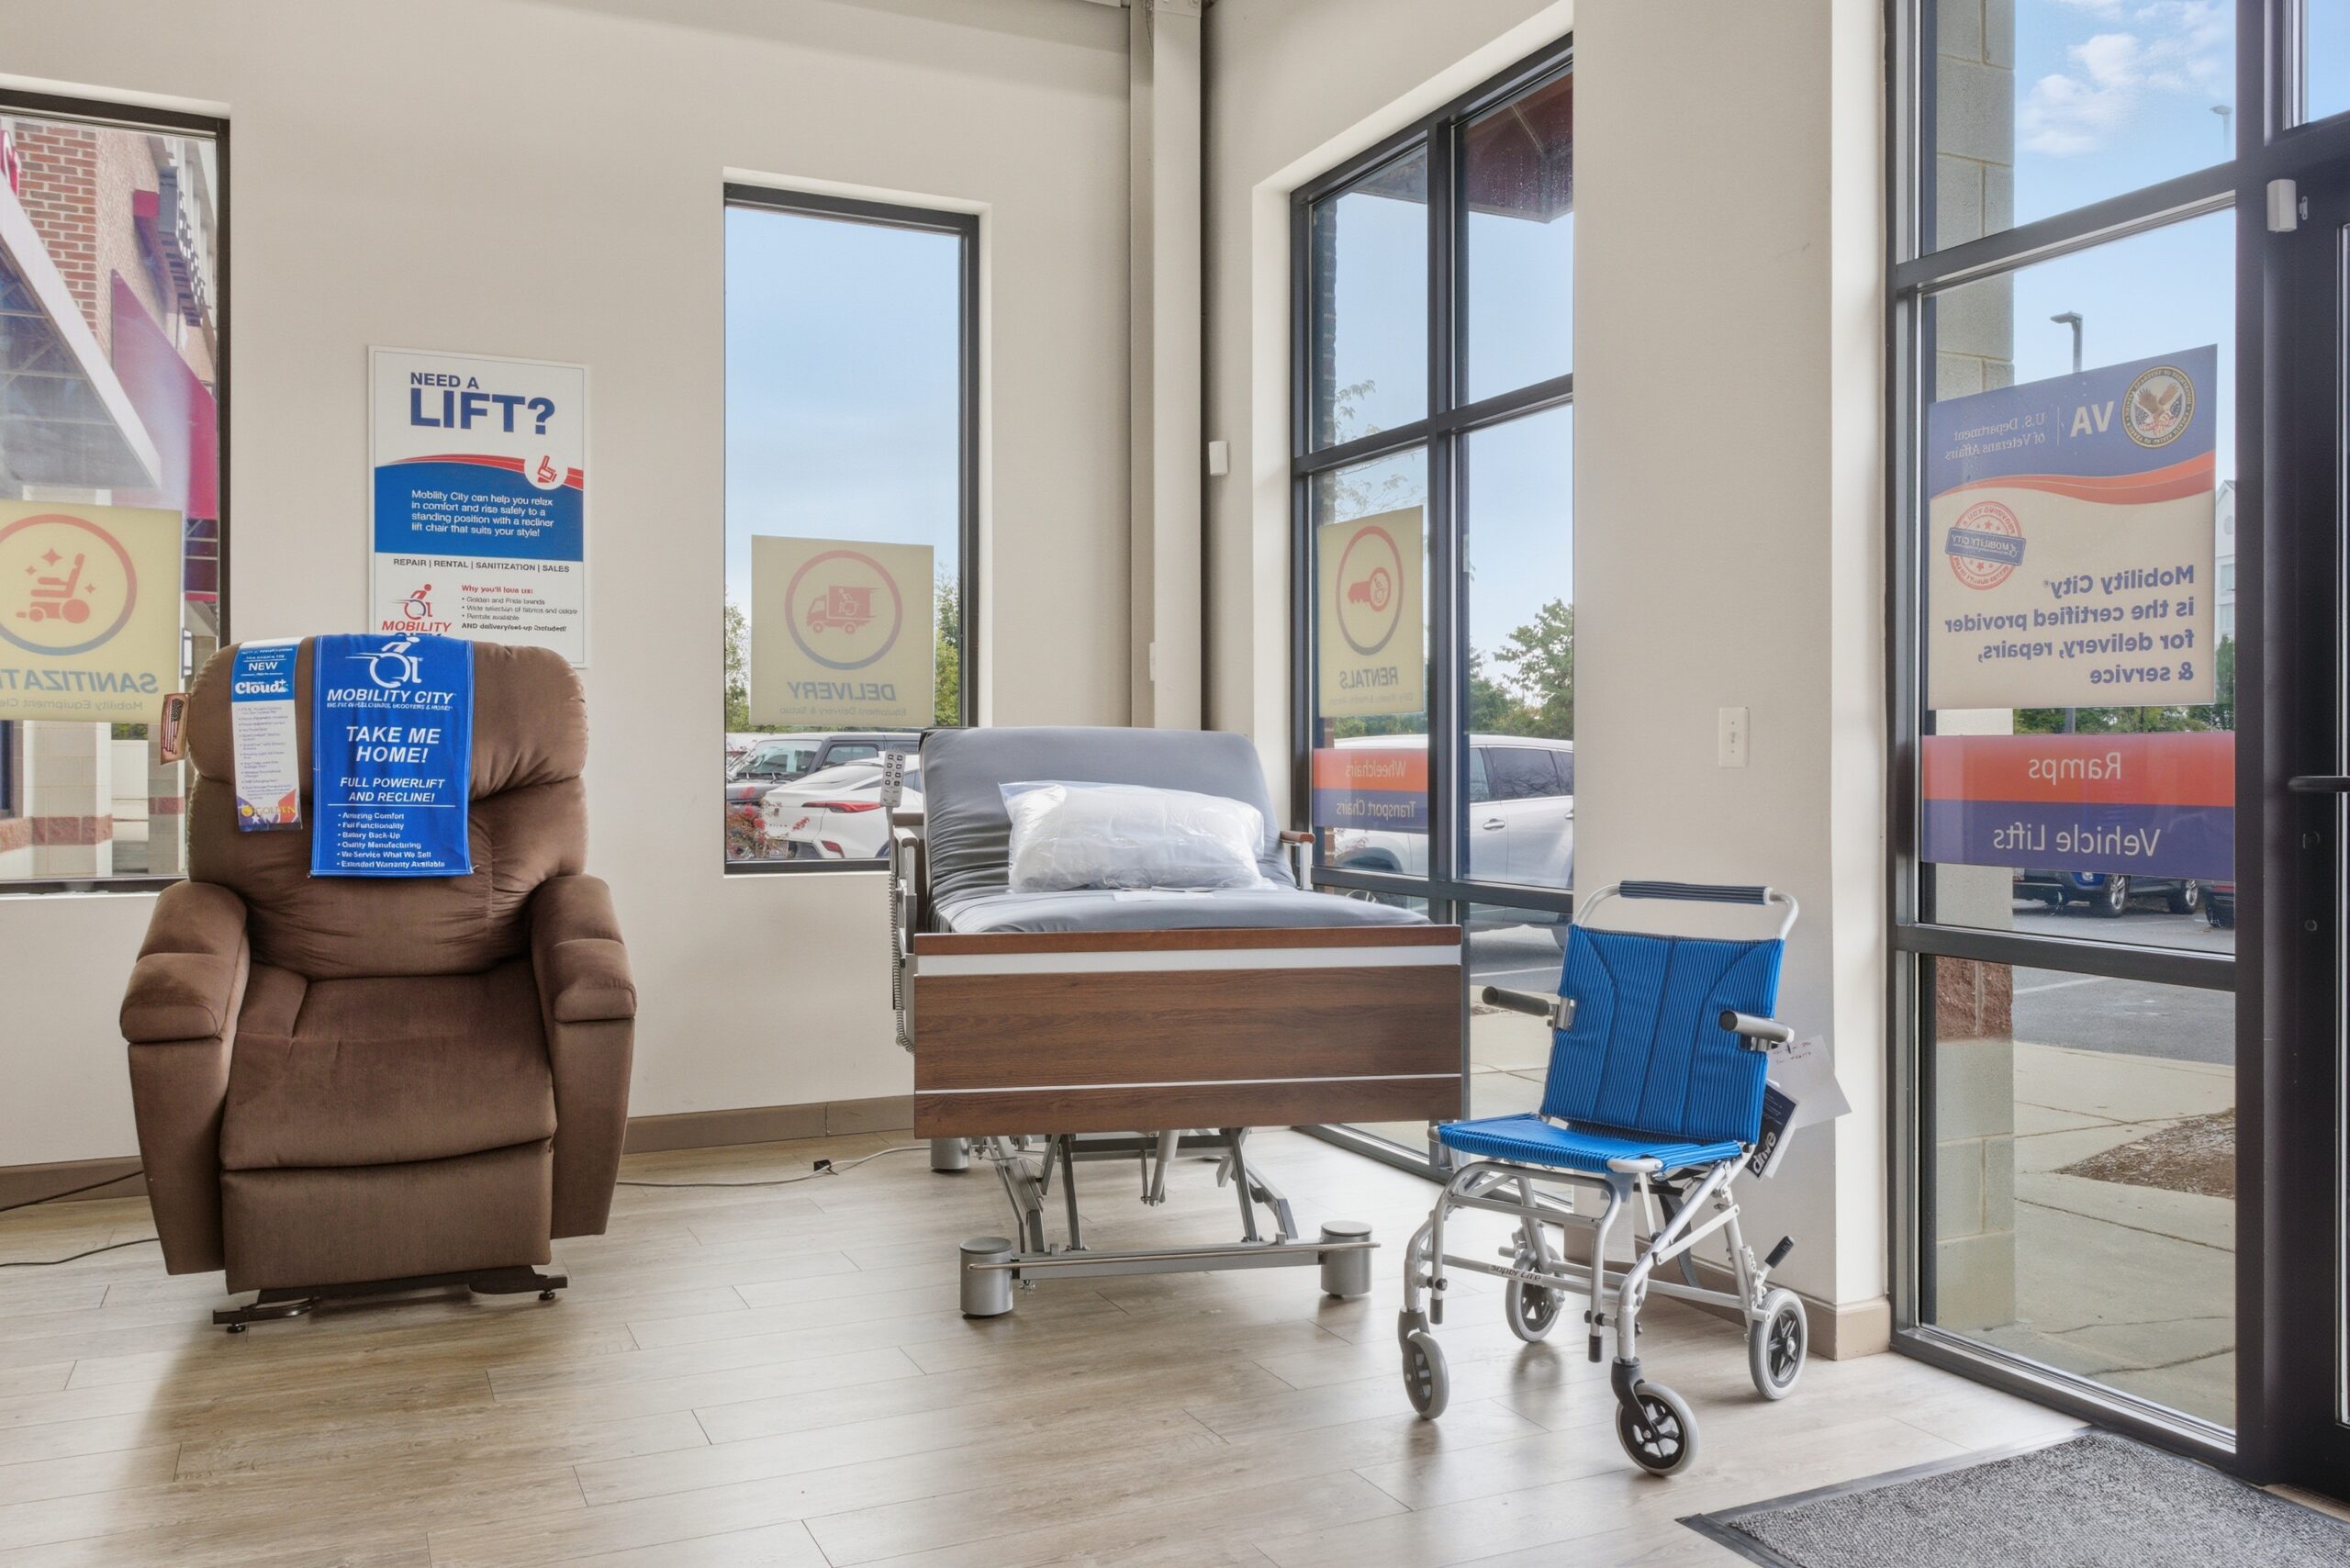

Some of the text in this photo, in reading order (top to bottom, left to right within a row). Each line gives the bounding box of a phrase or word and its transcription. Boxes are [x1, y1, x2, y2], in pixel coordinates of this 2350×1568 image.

[410, 372, 479, 389] NEED A
[410, 387, 555, 435] LIFT?
[411, 489, 554, 506] Mobility City can help you relax
[411, 501, 420, 510] in
[422, 502, 458, 511] comfort
[461, 504, 479, 512] and
[481, 504, 498, 513] rise
[500, 506, 526, 516] safely
[528, 508, 537, 516] to
[411, 512, 451, 523] standing
[453, 514, 489, 523] position
[492, 516, 511, 525] with
[521, 518, 554, 527] recliner
[411, 521, 540, 538] lift chair that suits your style!
[394, 558, 570, 573] REPAIR RENTAL SANITIZATION SALES
[461, 585, 478, 593] Why
[382, 620, 452, 633] MOBILITY
[248, 662, 278, 672] NEW
[327, 689, 453, 704] MOBILITY CITY
[346, 725, 442, 745] TAKE ME
[355, 745, 429, 764] HOME!
[340, 777, 445, 789] FULL POWERLIFT
[348, 791, 435, 802] AND RECLINE!
[342, 812, 373, 821] Amazing
[356, 822, 404, 830] Functionality
[368, 832, 401, 840] Back-Up
[341, 841, 366, 849] Quality
[1752, 1131, 1777, 1175] drive
